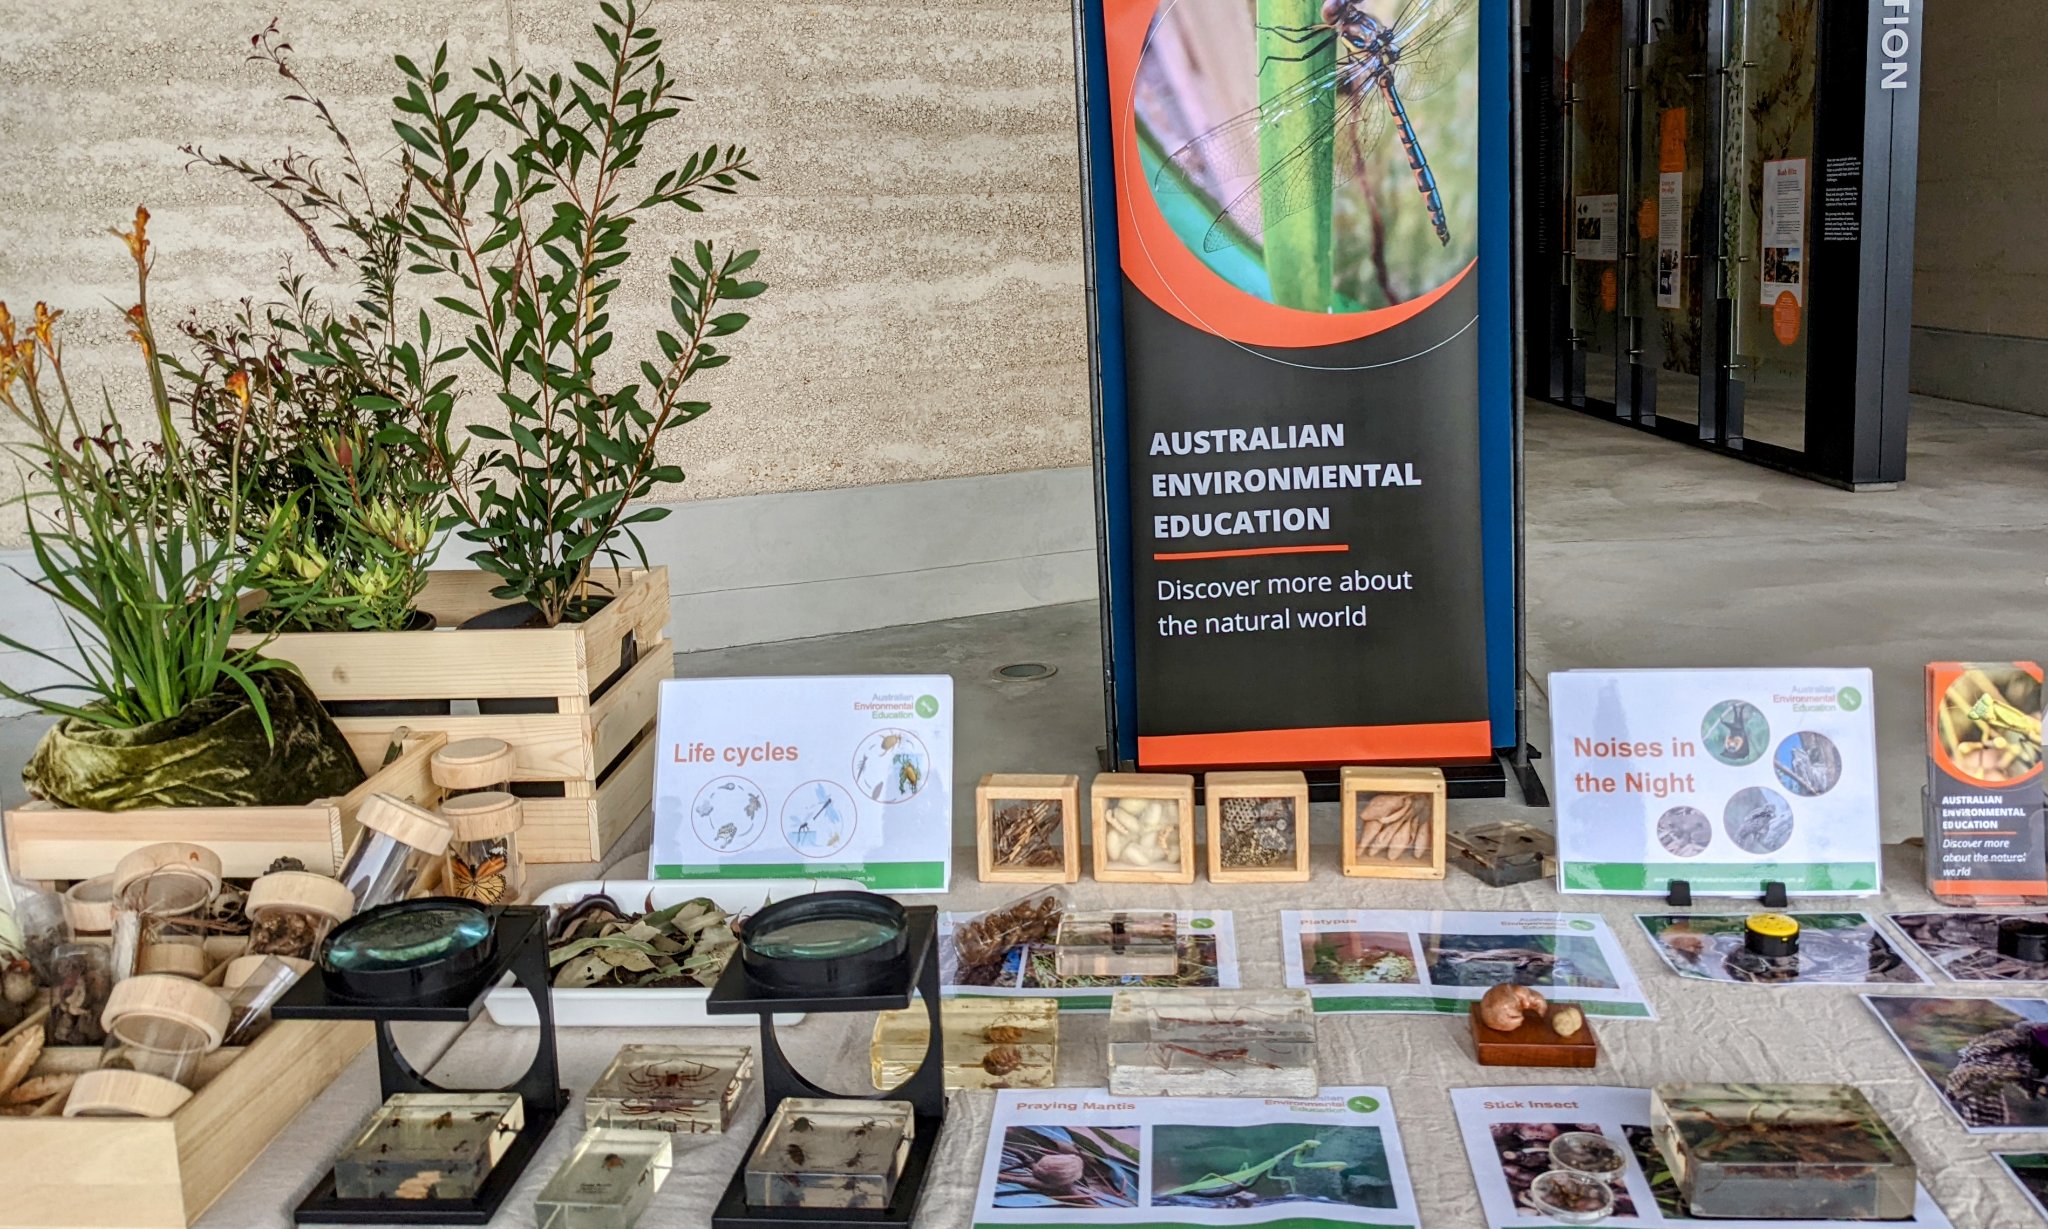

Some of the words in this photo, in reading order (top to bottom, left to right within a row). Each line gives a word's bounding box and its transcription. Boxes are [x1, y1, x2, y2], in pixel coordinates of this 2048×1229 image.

[1881, 0, 1910, 89] TION
[1149, 423, 1345, 456] AUSTRALIAN
[1152, 462, 1422, 498] ENVIRONMENTAL
[1154, 507, 1331, 538] EDUCATION
[1157, 578, 1261, 601] Discover
[1268, 575, 1332, 594] more
[1339, 569, 1413, 592] about
[1158, 614, 1198, 636] the
[1205, 608, 1291, 633] natural
[1298, 605, 1368, 628] world
[854, 702, 914, 710] Environmental
[674, 742, 716, 763] Life
[722, 741, 799, 767] cycles
[1573, 736, 1663, 758] Noises
[1672, 736, 1696, 757] in
[1575, 772, 1616, 793] the
[1624, 771, 1696, 798] Night
[1942, 795, 2003, 805] AUSTRALIAN
[1942, 808, 2026, 817] ENVIRONMENTAL
[1942, 820, 1999, 829] EDUCATION
[1942, 839, 1982, 848] Discover
[1984, 840, 2010, 848] more
[1942, 853, 1971, 863] about
[1973, 852, 1988, 862] the
[1016, 1101, 1078, 1113] Praying
[1083, 1101, 1136, 1111] Mantis
[1483, 1100, 1524, 1110] Stick
[1528, 1100, 1579, 1110] Insect
